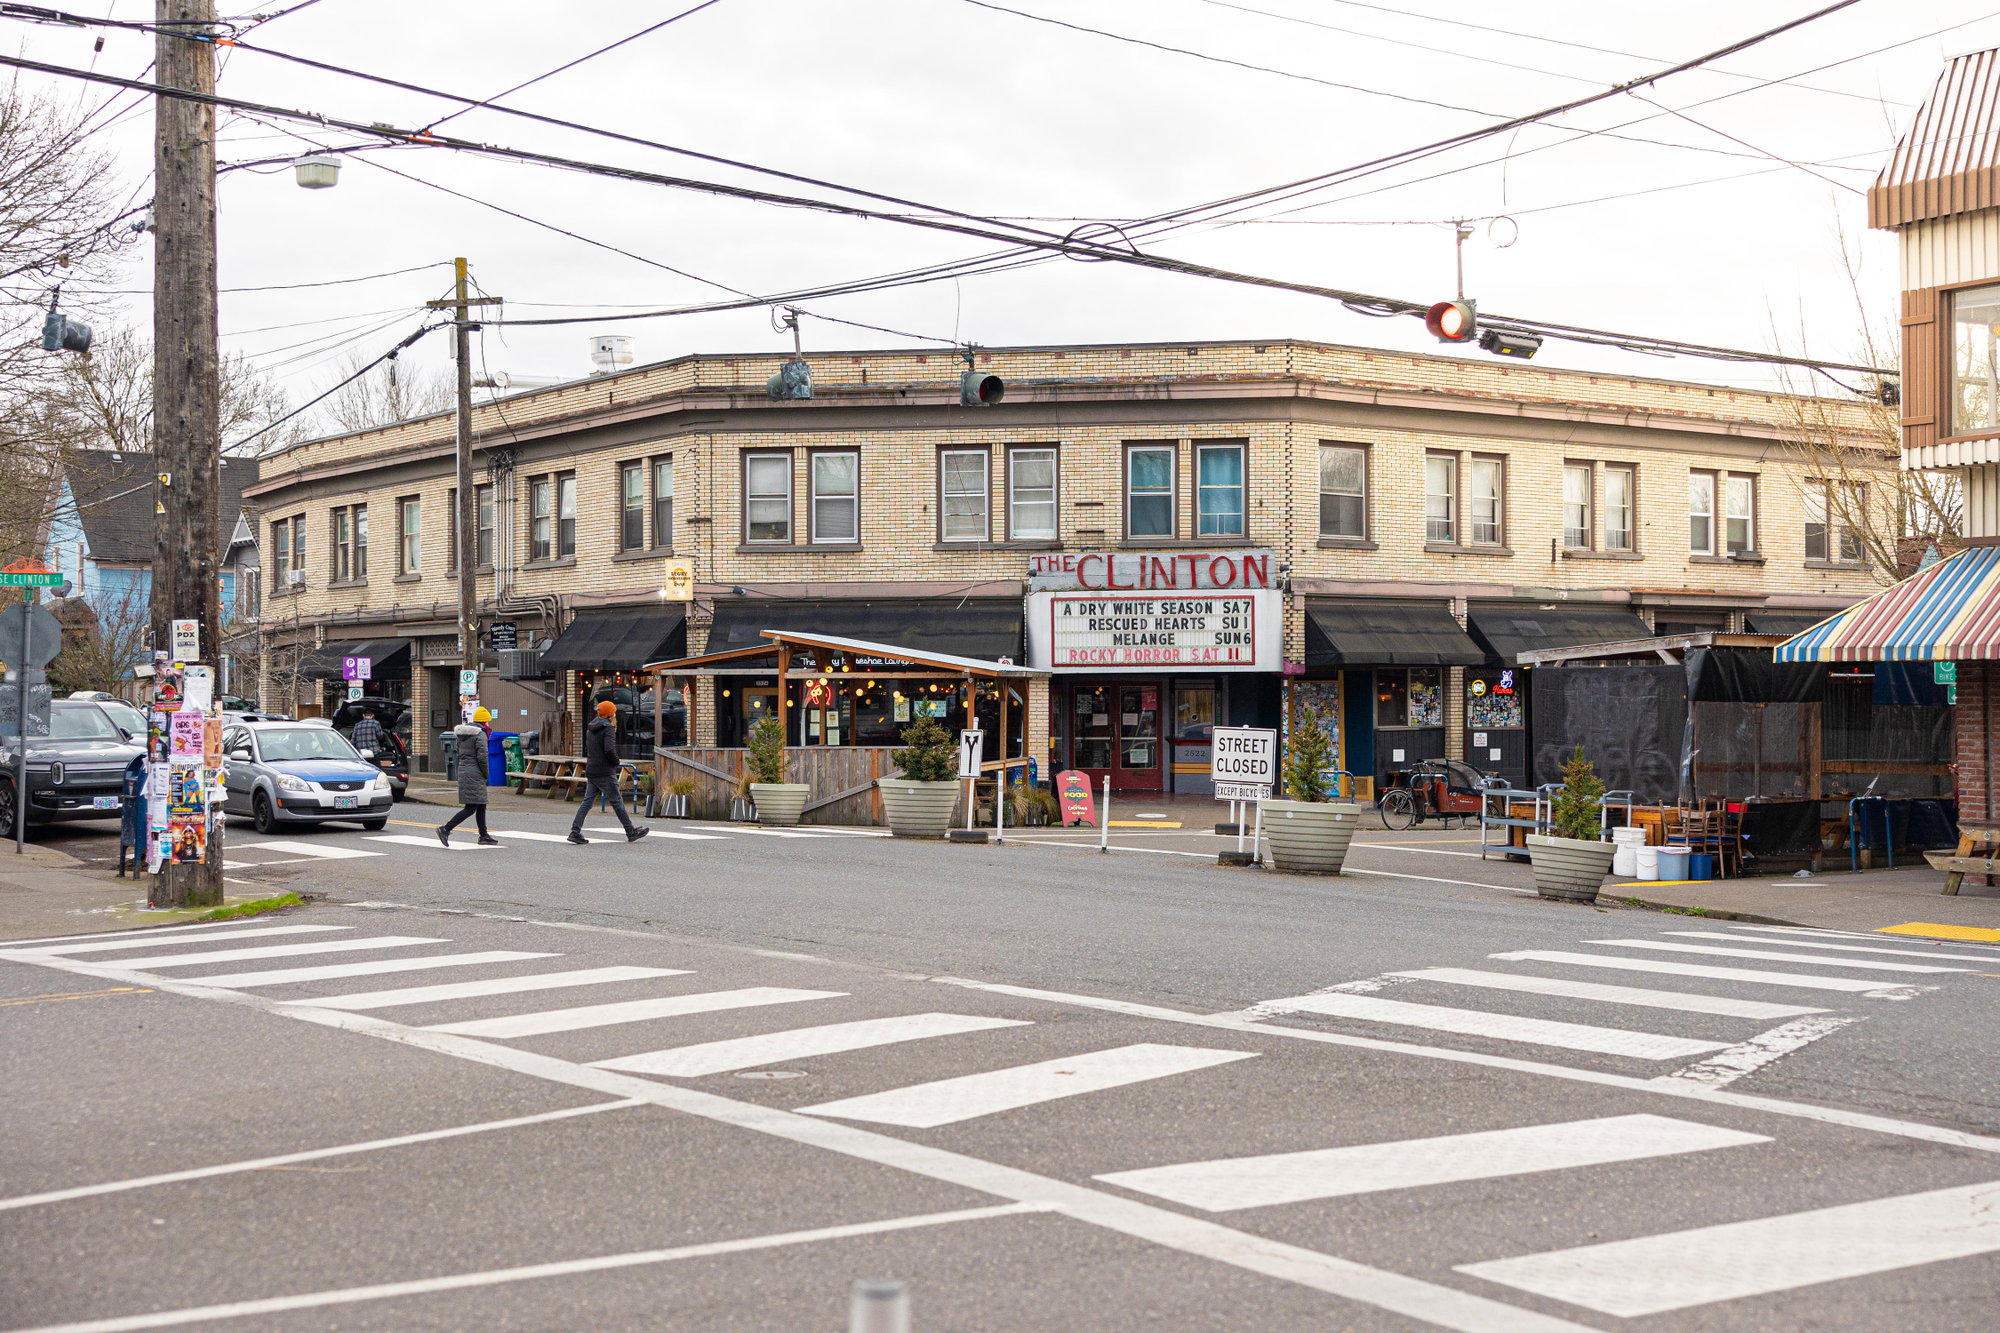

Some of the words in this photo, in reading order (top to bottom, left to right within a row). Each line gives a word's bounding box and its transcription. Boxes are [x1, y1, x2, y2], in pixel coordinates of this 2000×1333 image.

[1032, 555, 1076, 572] THE
[1077, 554, 1269, 590] CLINTON
[13, 574, 50, 585] CLINTON
[1064, 603, 1072, 615] A
[1080, 603, 1106, 615] DRY
[1113, 602, 1154, 615] WHITE
[1161, 601, 1213, 615] SEASON
[1089, 618, 1148, 630] RESCUED
[1155, 617, 1206, 630] HEARTS
[1113, 632, 1175, 646] MELANGE
[1069, 648, 1117, 662] ROCKY
[1124, 647, 1180, 661] HORROR
[1191, 647, 1219, 661] SAT
[800, 657, 817, 666] The
[884, 657, 914, 667] Loung
[1939, 673, 1954, 681] BIKE
[1218, 737, 1268, 754] STREET
[1184, 749, 1206, 757] 2522
[1217, 757, 1268, 775] CLOSED
[1217, 786, 1238, 797] EXCEPT
[1240, 787, 1270, 799] BICYCES
